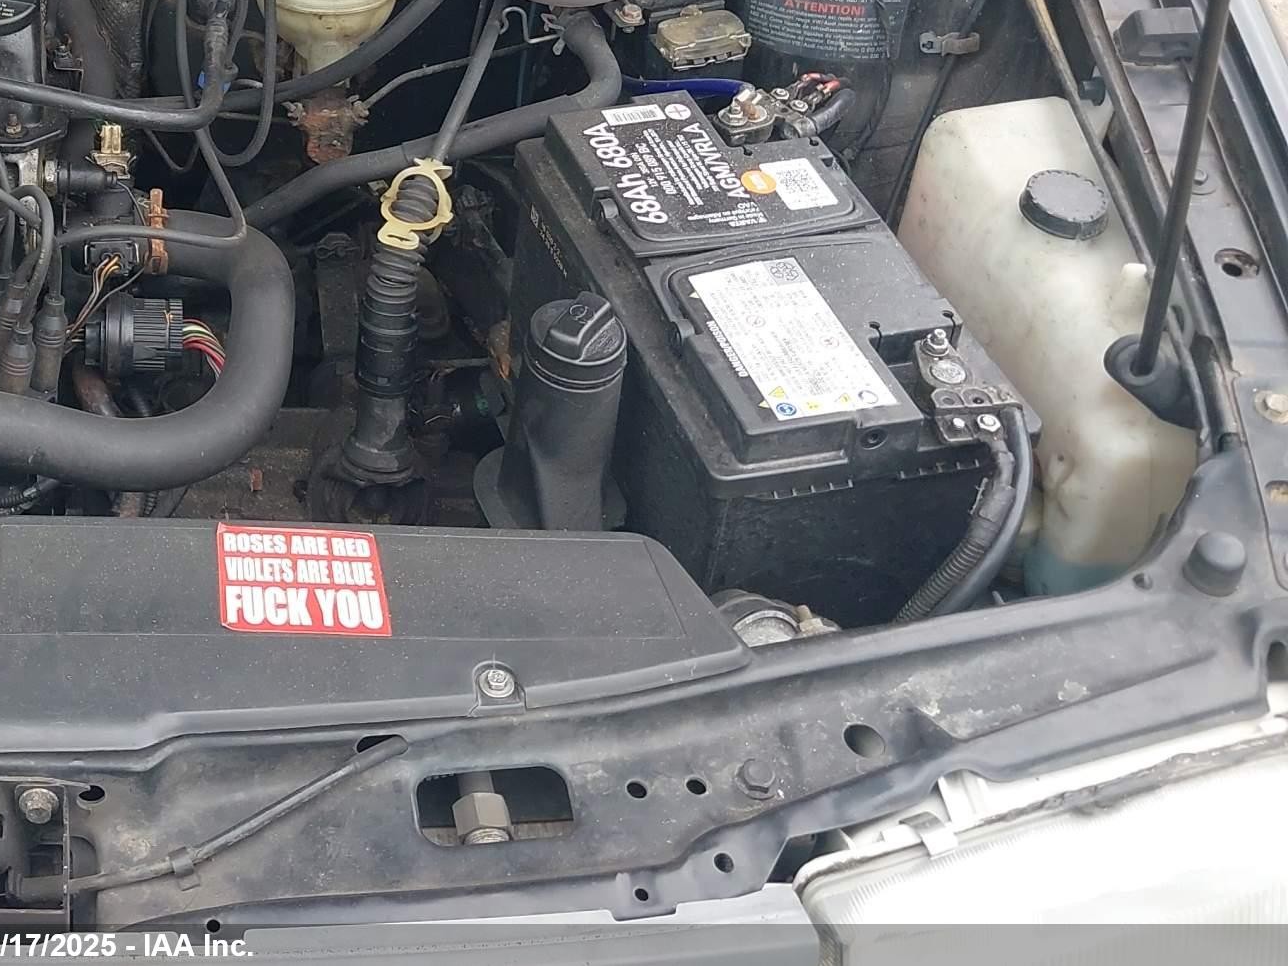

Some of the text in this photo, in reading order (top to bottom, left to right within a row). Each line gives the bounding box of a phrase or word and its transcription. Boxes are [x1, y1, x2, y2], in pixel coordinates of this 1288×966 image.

[583, 122, 668, 224] 68Ah 680A
[681, 122, 752, 199] AGM/VRLA
[660, 181, 677, 194] 000
[706, 319, 749, 378] DANGER/POISON
[223, 532, 371, 558] ROSES ARE RED
[225, 557, 376, 586] VIOLETS ARE BLUE
[225, 585, 384, 630] FUCK YOU
